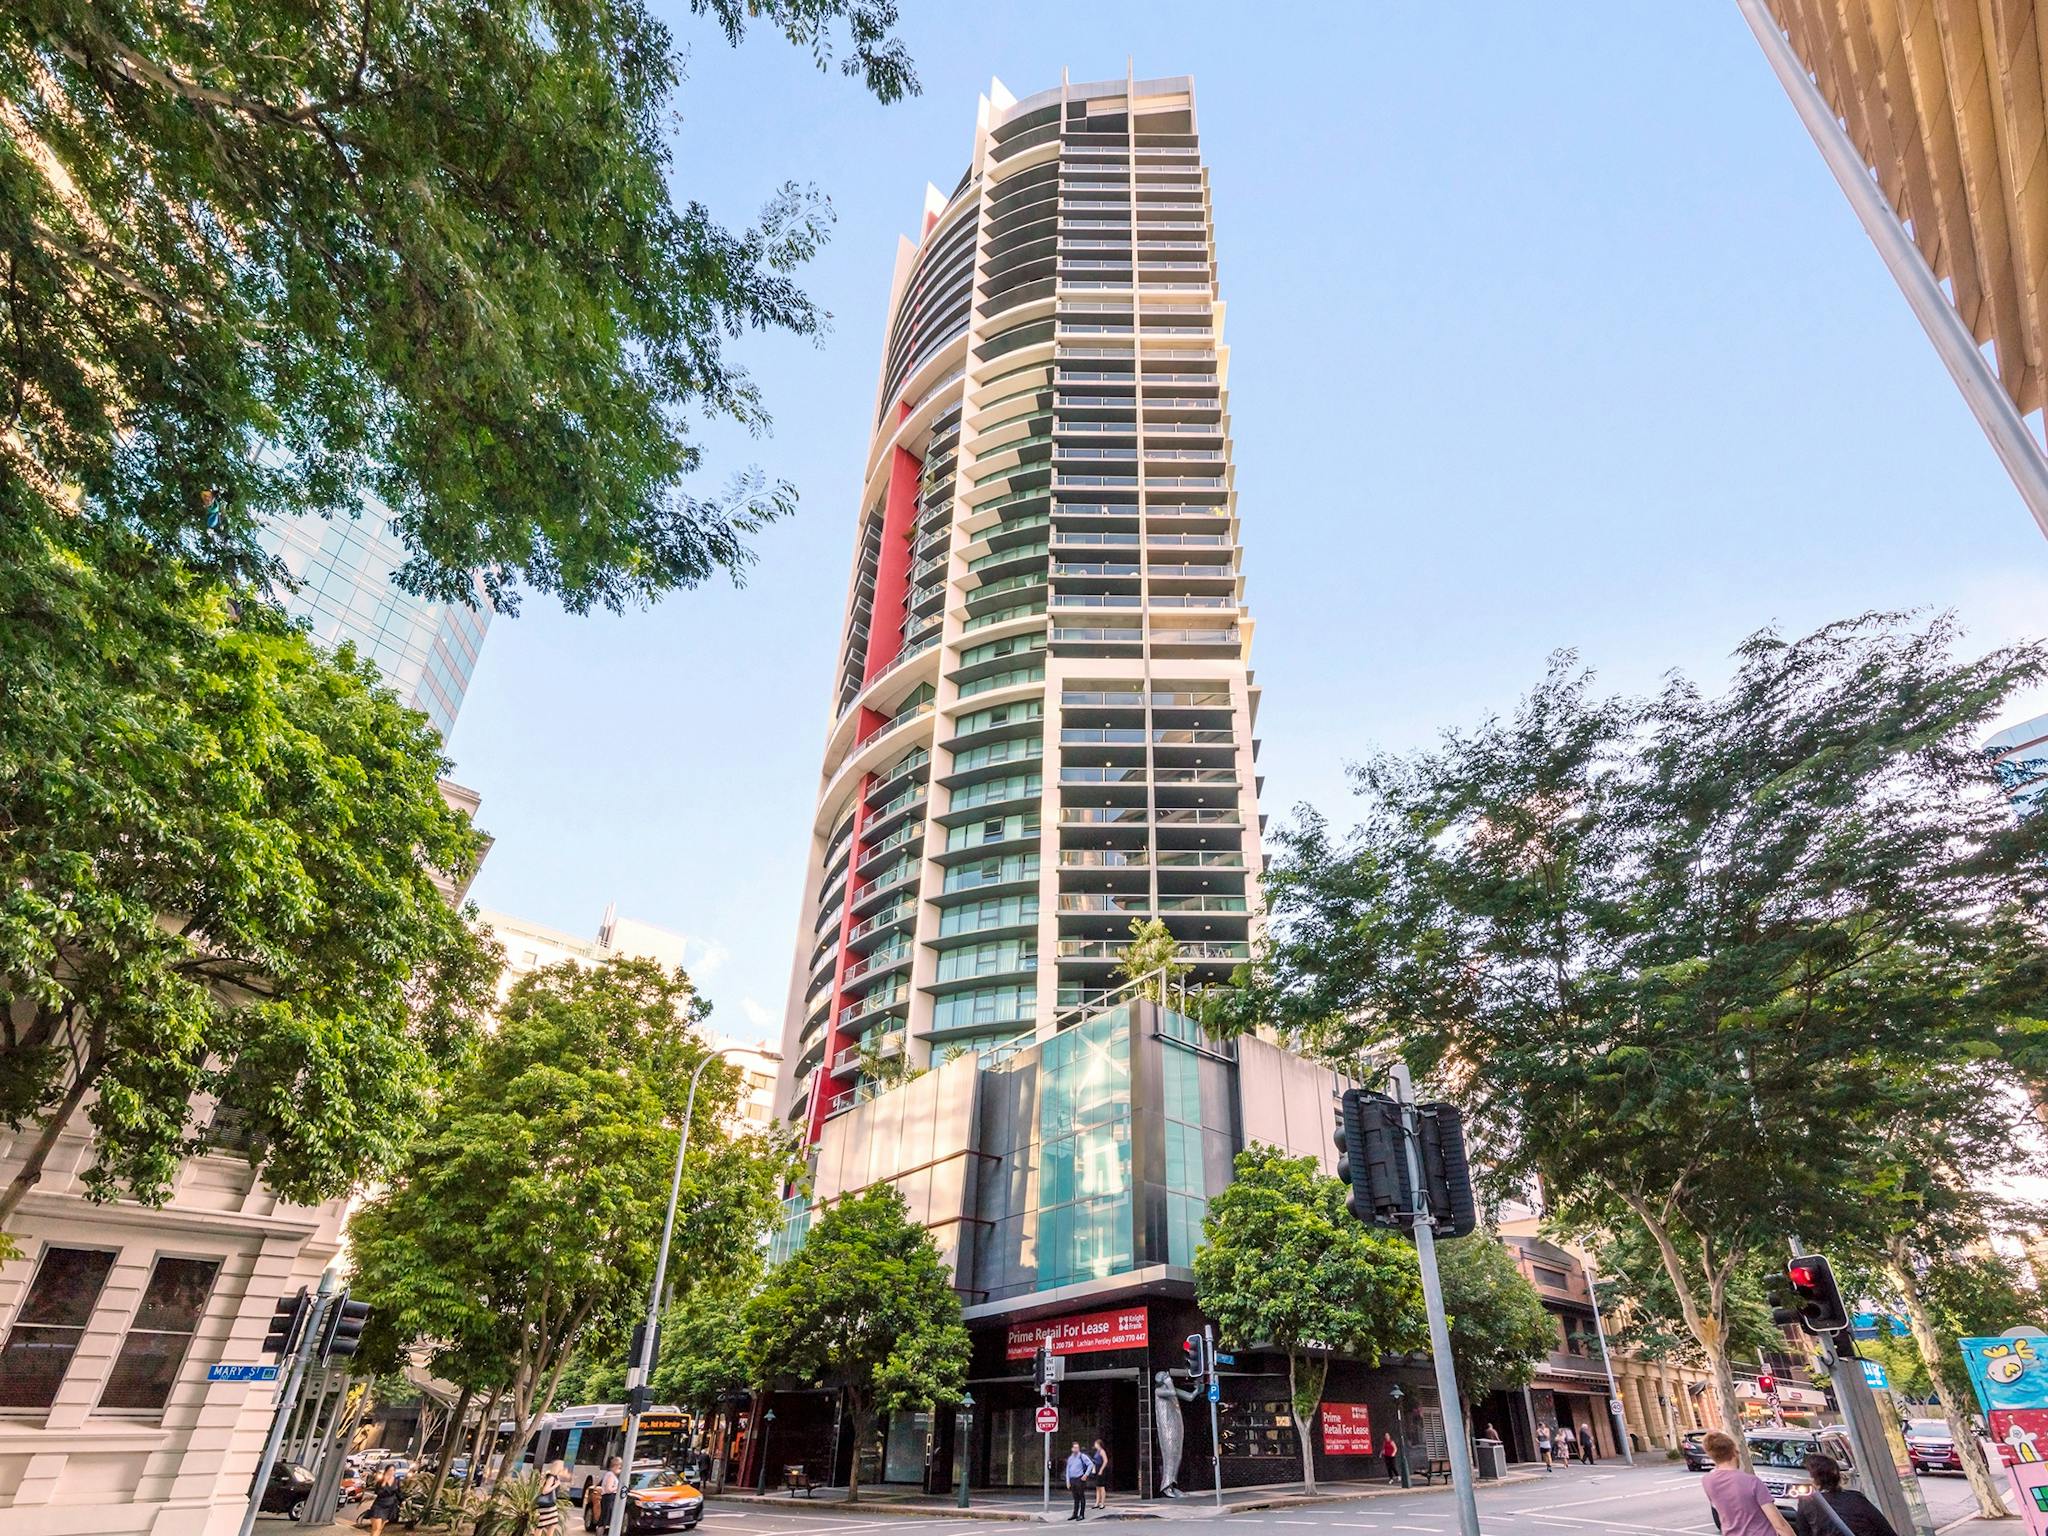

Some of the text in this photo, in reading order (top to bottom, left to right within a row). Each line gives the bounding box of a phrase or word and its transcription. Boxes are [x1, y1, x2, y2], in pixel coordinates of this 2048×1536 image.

[1008, 1322, 1109, 1344] Prime Retail For Lease
[213, 1366, 244, 1376] MARY
[1323, 1412, 1341, 1422] Prime
[1324, 1423, 1369, 1435] Retail For Lease
